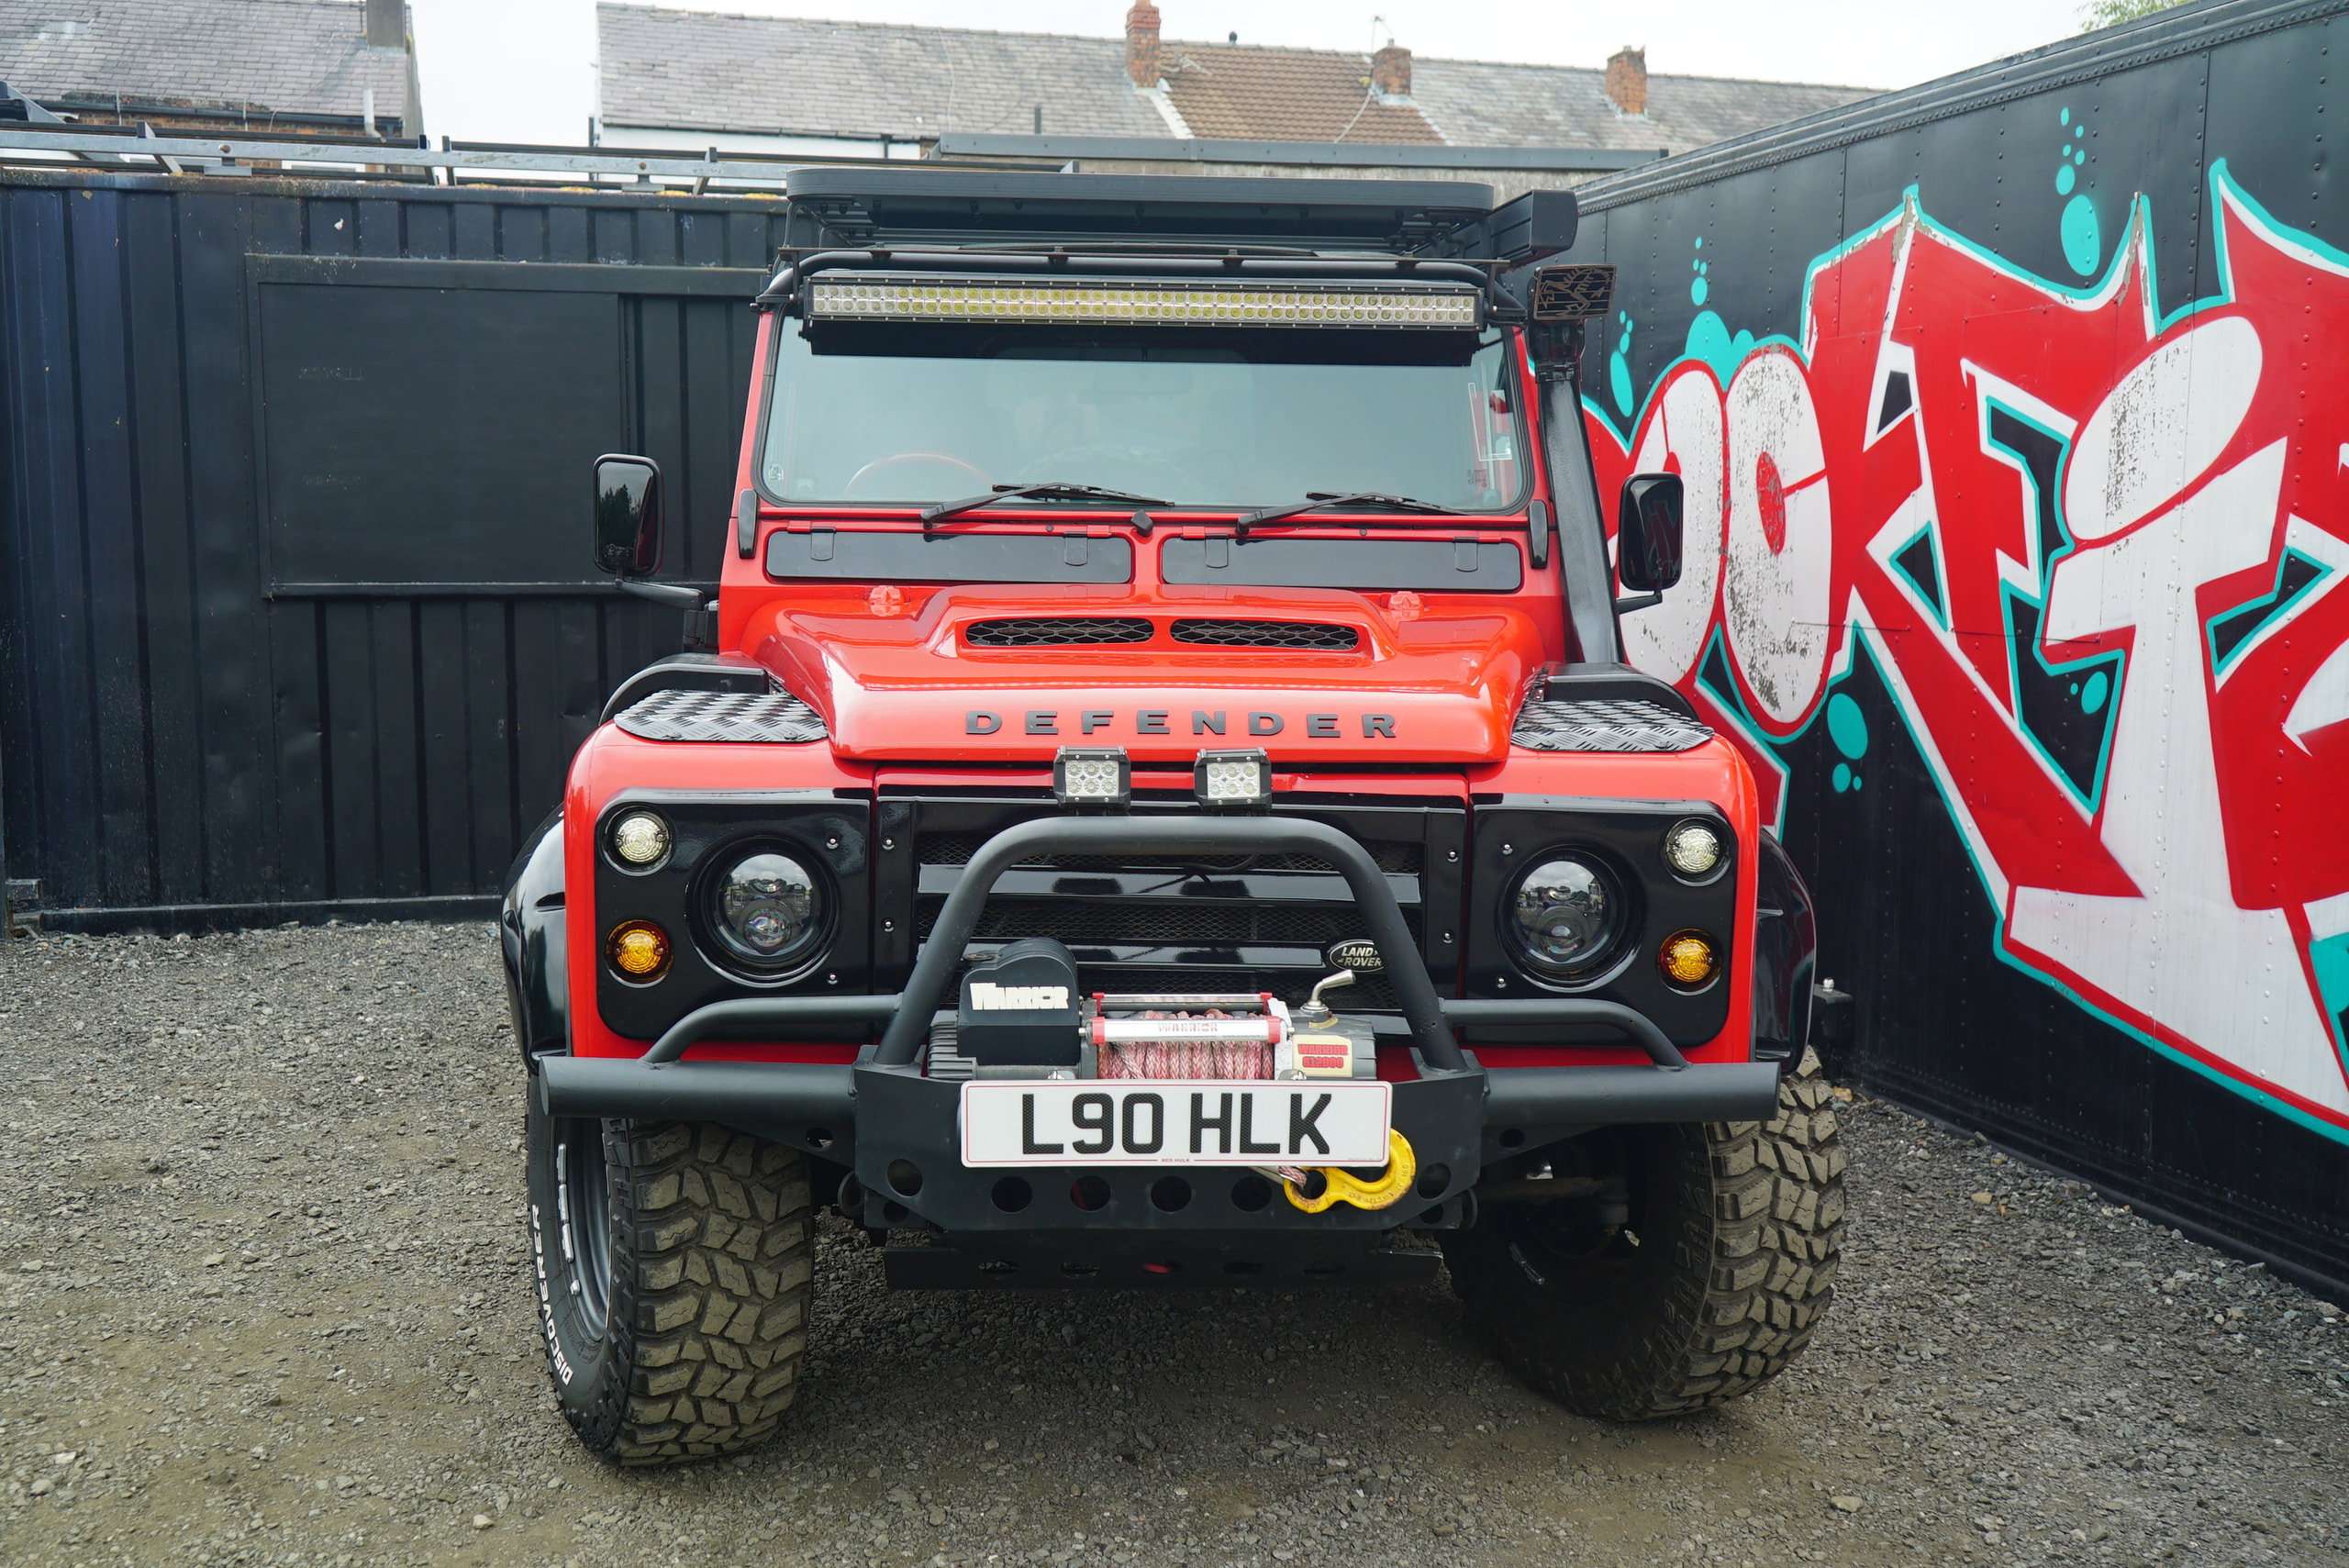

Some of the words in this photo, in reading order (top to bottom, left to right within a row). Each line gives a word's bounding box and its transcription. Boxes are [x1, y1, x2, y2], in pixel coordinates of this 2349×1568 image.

[965, 709, 1398, 739] DEFENDER
[1341, 946, 1375, 957] LAND
[1343, 957, 1382, 967] ROVER
[1158, 1021, 1219, 1033] WARRIOR
[1021, 1093, 1164, 1155] L90
[1189, 1093, 1332, 1155] HLK
[531, 1204, 574, 1386] DISCOVERER
